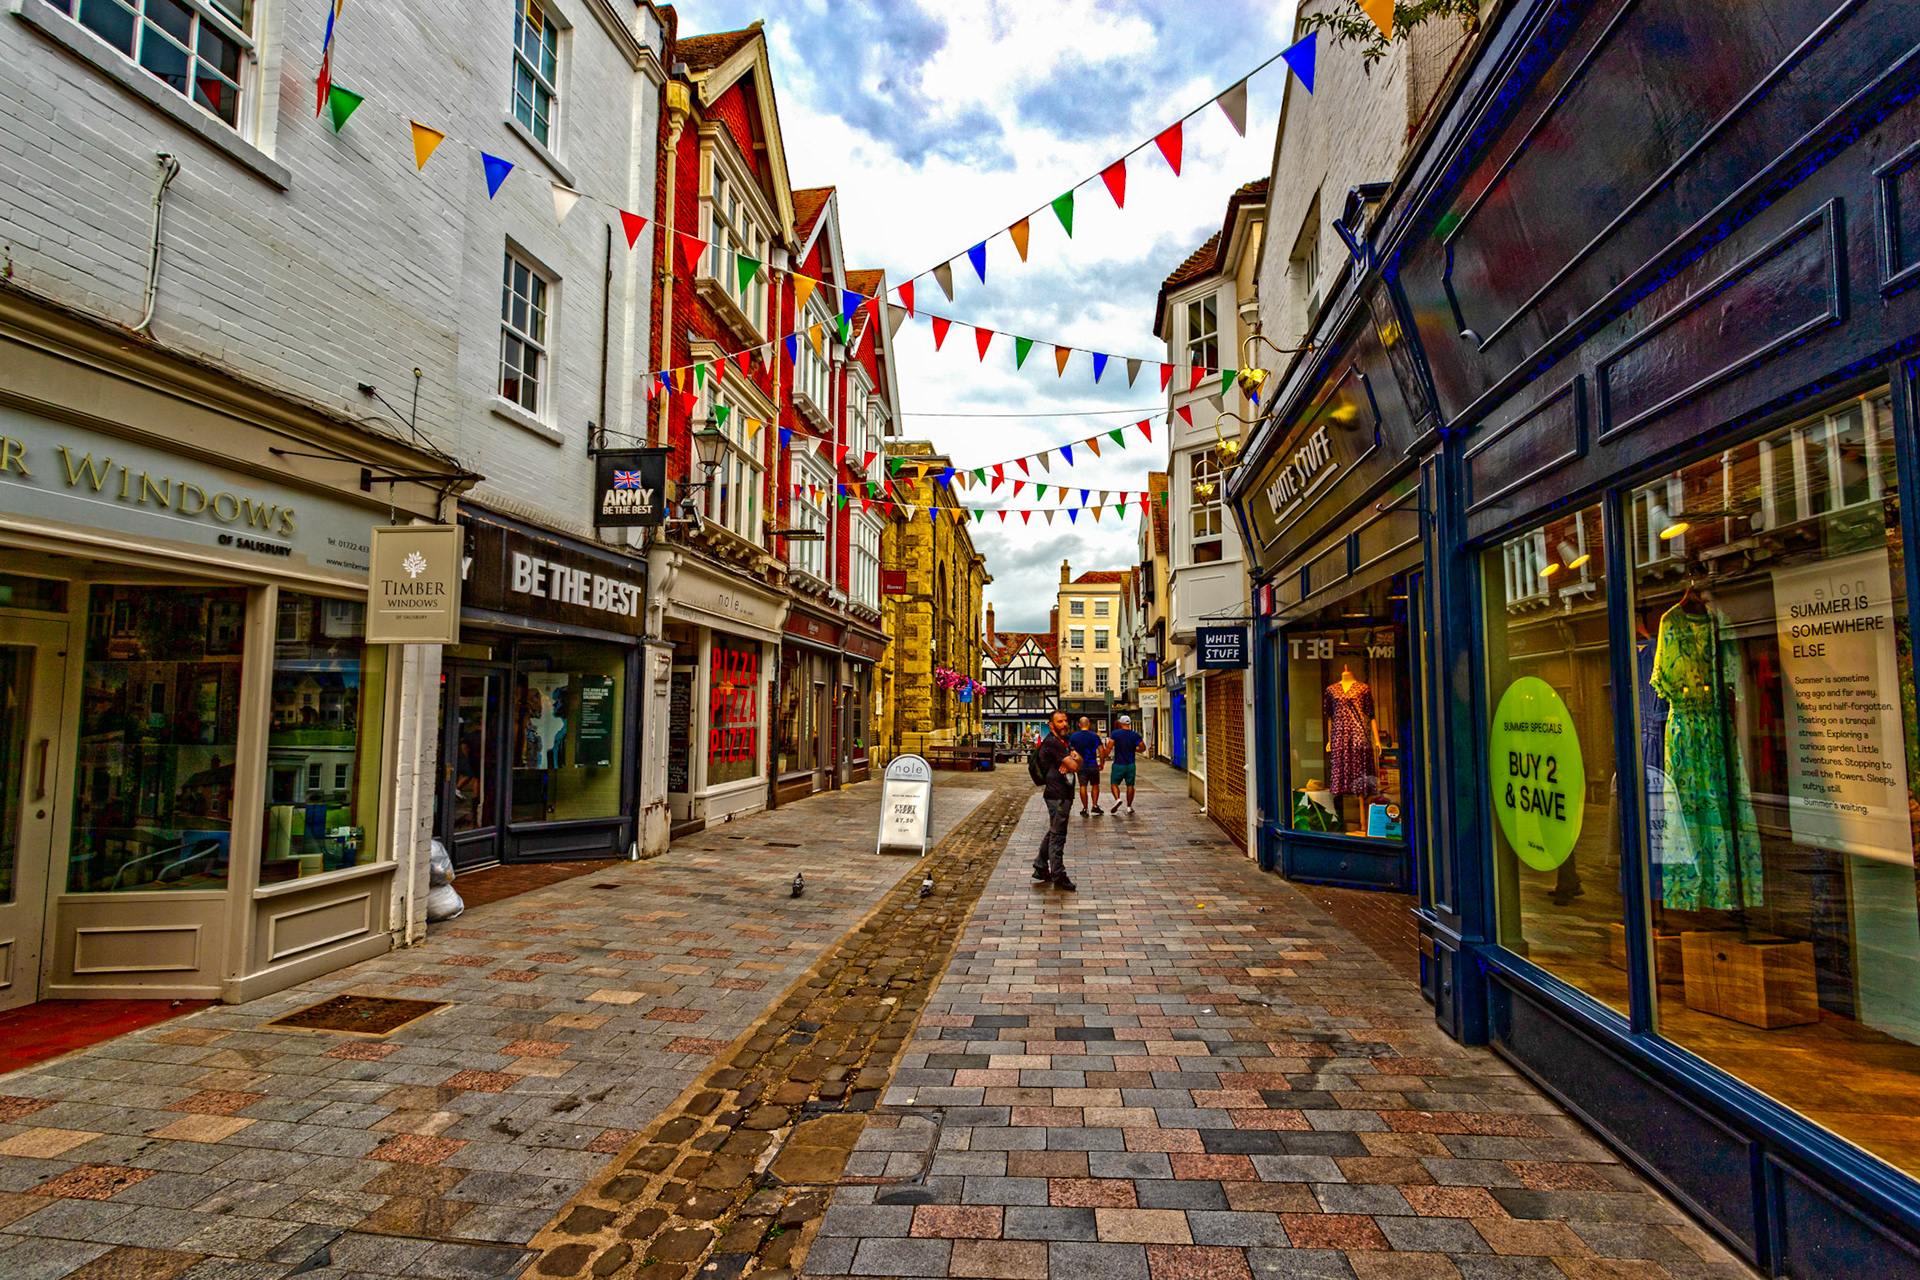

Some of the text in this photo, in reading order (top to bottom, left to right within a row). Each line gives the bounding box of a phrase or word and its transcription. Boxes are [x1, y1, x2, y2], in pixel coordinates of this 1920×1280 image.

[1266, 425, 1330, 515] WHITE STUFF
[57, 444, 295, 534] WINDOWS
[603, 488, 654, 506] ARMY
[603, 505, 653, 515] BE THE BEST
[218, 534, 292, 556] OF SALISBURY
[338, 540, 358, 551] 01722
[381, 579, 446, 595] TIMBER
[461, 552, 642, 618] Y BE THE BEST
[388, 599, 438, 607] WINDOWS
[719, 590, 739, 610] nole
[1790, 595, 1868, 619] SUMMER IS
[1792, 616, 1885, 639] SOMEWHERE
[1205, 634, 1239, 645] WHITE
[1205, 648, 1239, 659] STUFF
[1793, 643, 1826, 659] ELSE
[712, 647, 757, 687] PIZZA
[1795, 674, 1870, 685] Summer is sometime
[1795, 689, 1878, 699] long ago and far away.
[711, 687, 756, 724] PIZZA
[1796, 702, 1894, 712] Misty and half-forgotten.
[1504, 722, 1562, 734] SUMMER SPECIALS
[1797, 716, 1827, 726] Floating
[1845, 716, 1876, 726] tranquil
[1826, 729, 1863, 741] Exploring
[709, 727, 756, 765] PIZZA
[1799, 743, 1879, 754] curious garden. Little
[895, 763, 923, 774] nole
[1509, 751, 1557, 784] BUY 2
[1800, 755, 1892, 770] adventures. Stopping to
[1801, 769, 1896, 786] smell the flowers. Sleepy,
[1505, 782, 1566, 821] & SAVE
[1803, 797, 1869, 815] Summer's waiting.
